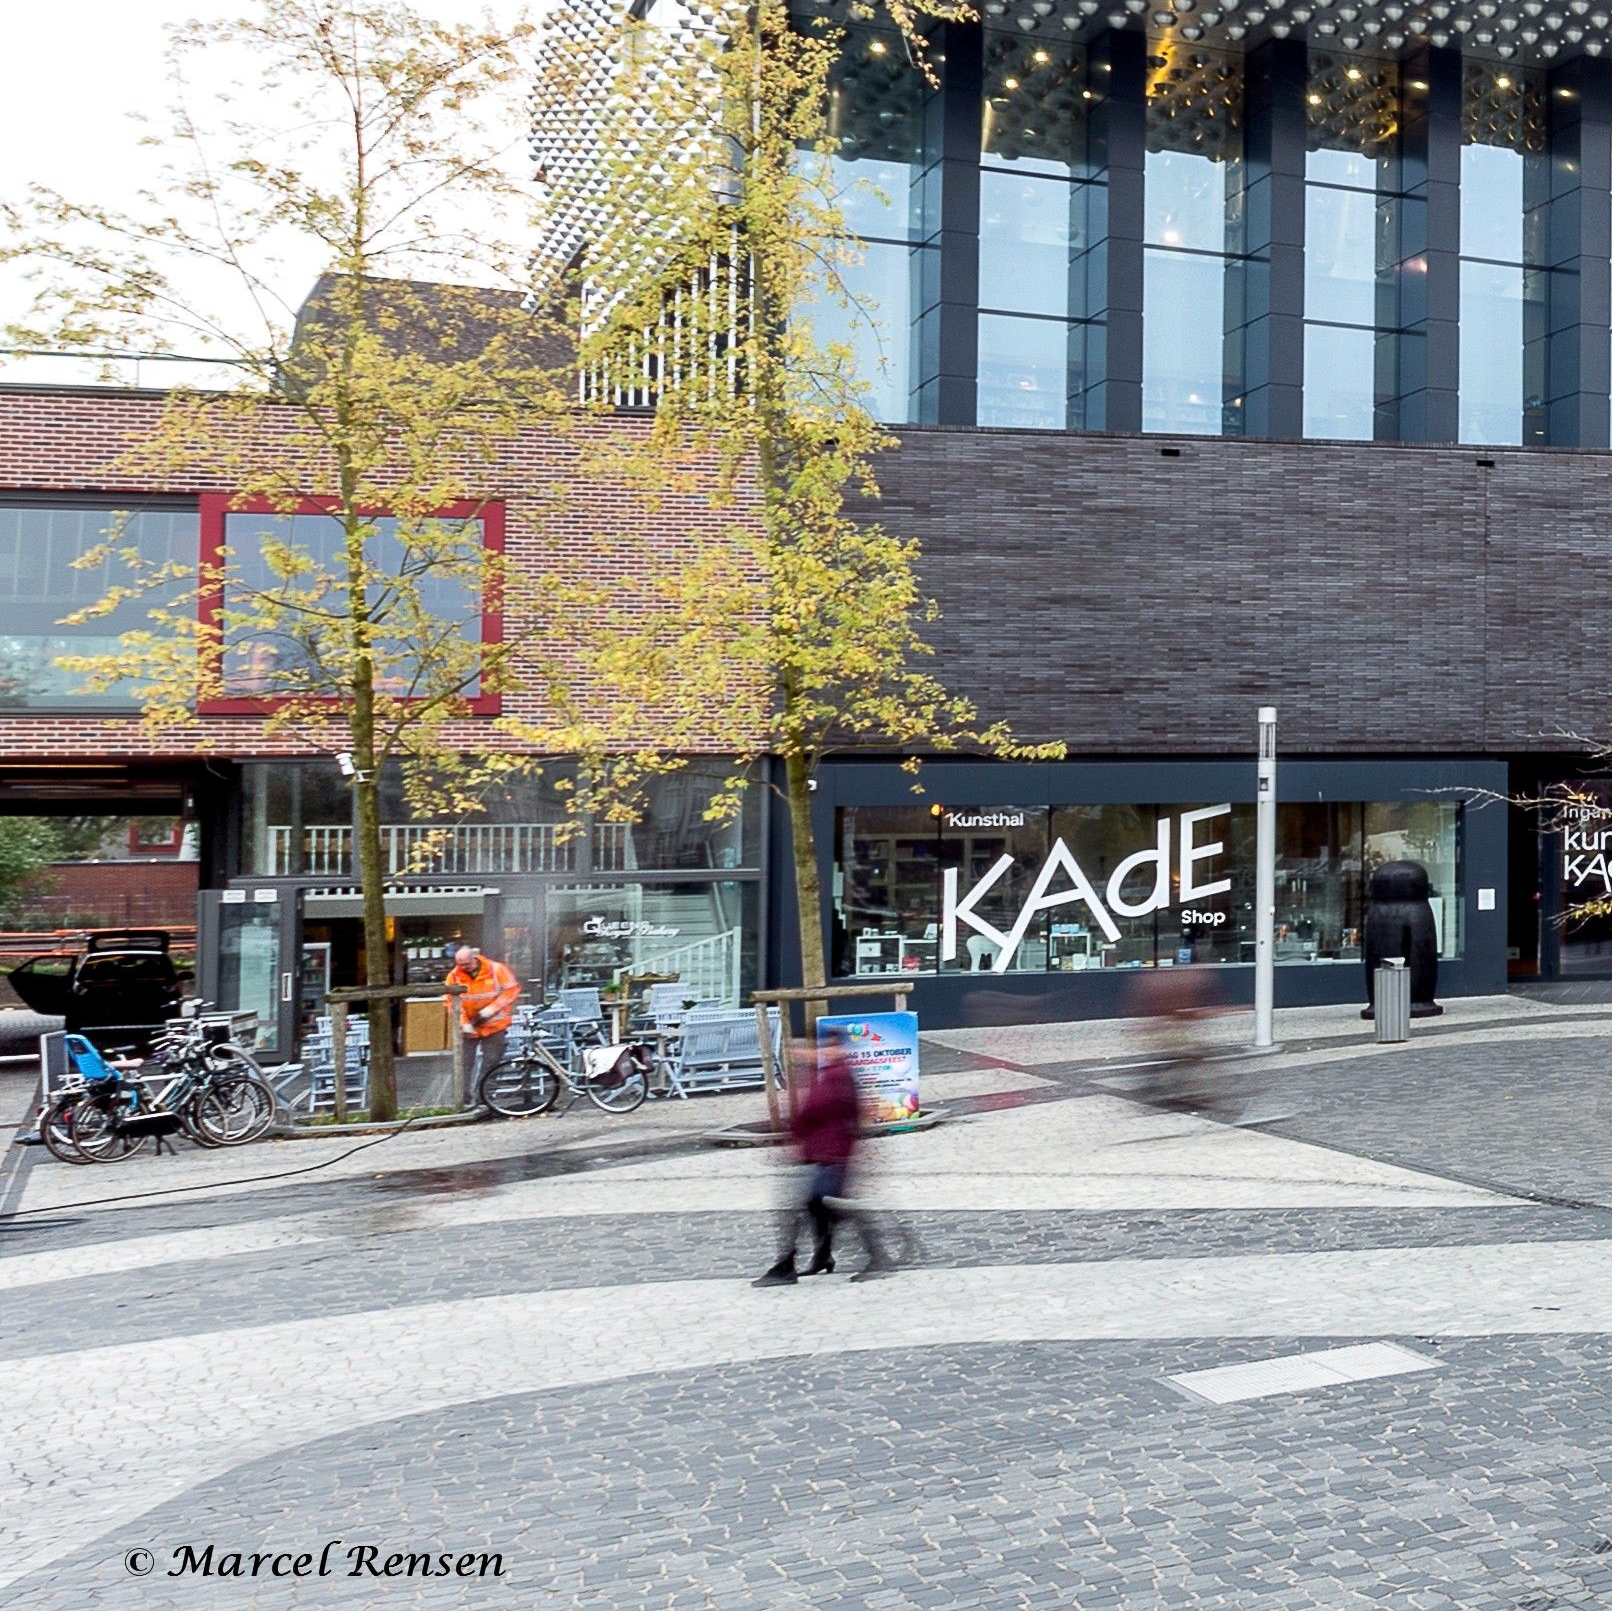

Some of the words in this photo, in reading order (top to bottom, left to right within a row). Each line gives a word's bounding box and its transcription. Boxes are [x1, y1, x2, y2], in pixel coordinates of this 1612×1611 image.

[949, 812, 1024, 828] Kunsthal
[942, 802, 1232, 975] KAdE
[1181, 909, 1226, 927] Shop
